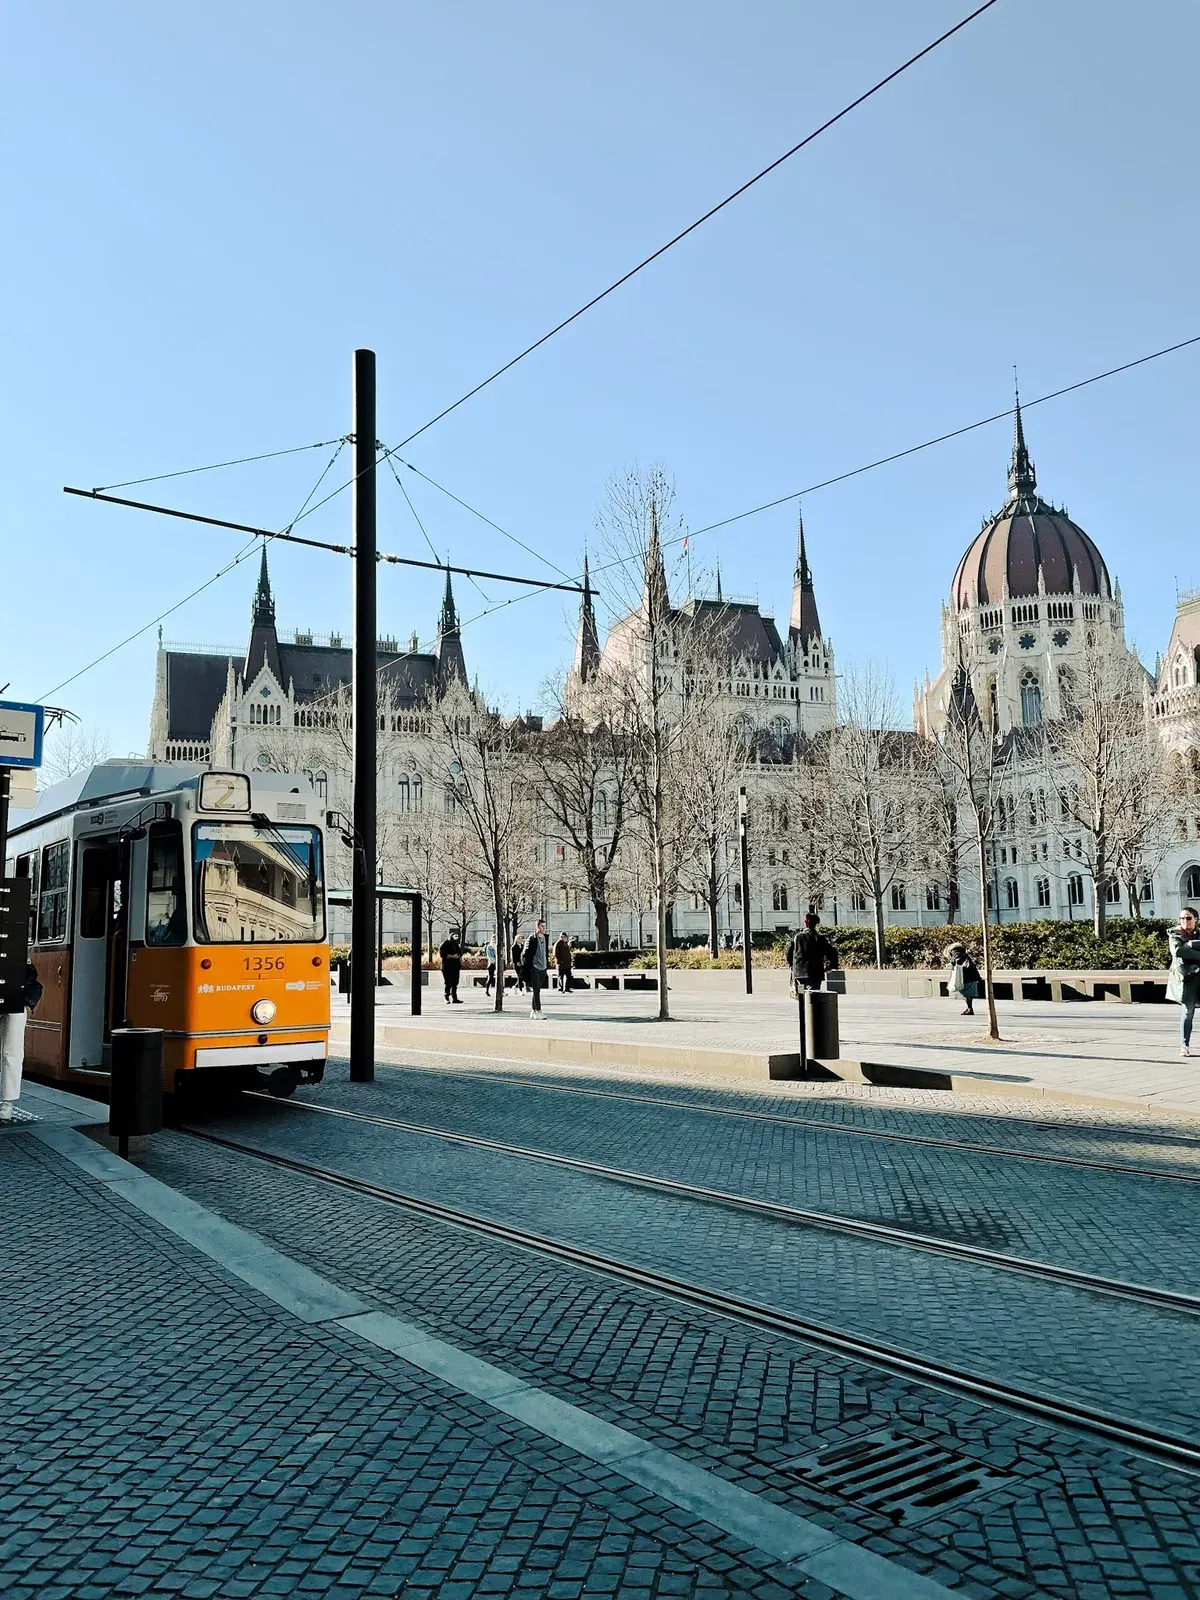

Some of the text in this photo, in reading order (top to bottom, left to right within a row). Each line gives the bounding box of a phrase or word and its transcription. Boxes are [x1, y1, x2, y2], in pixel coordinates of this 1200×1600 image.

[214, 779, 236, 808] 2
[243, 956, 285, 971] 1356
[216, 984, 256, 992] BUDAPEST
